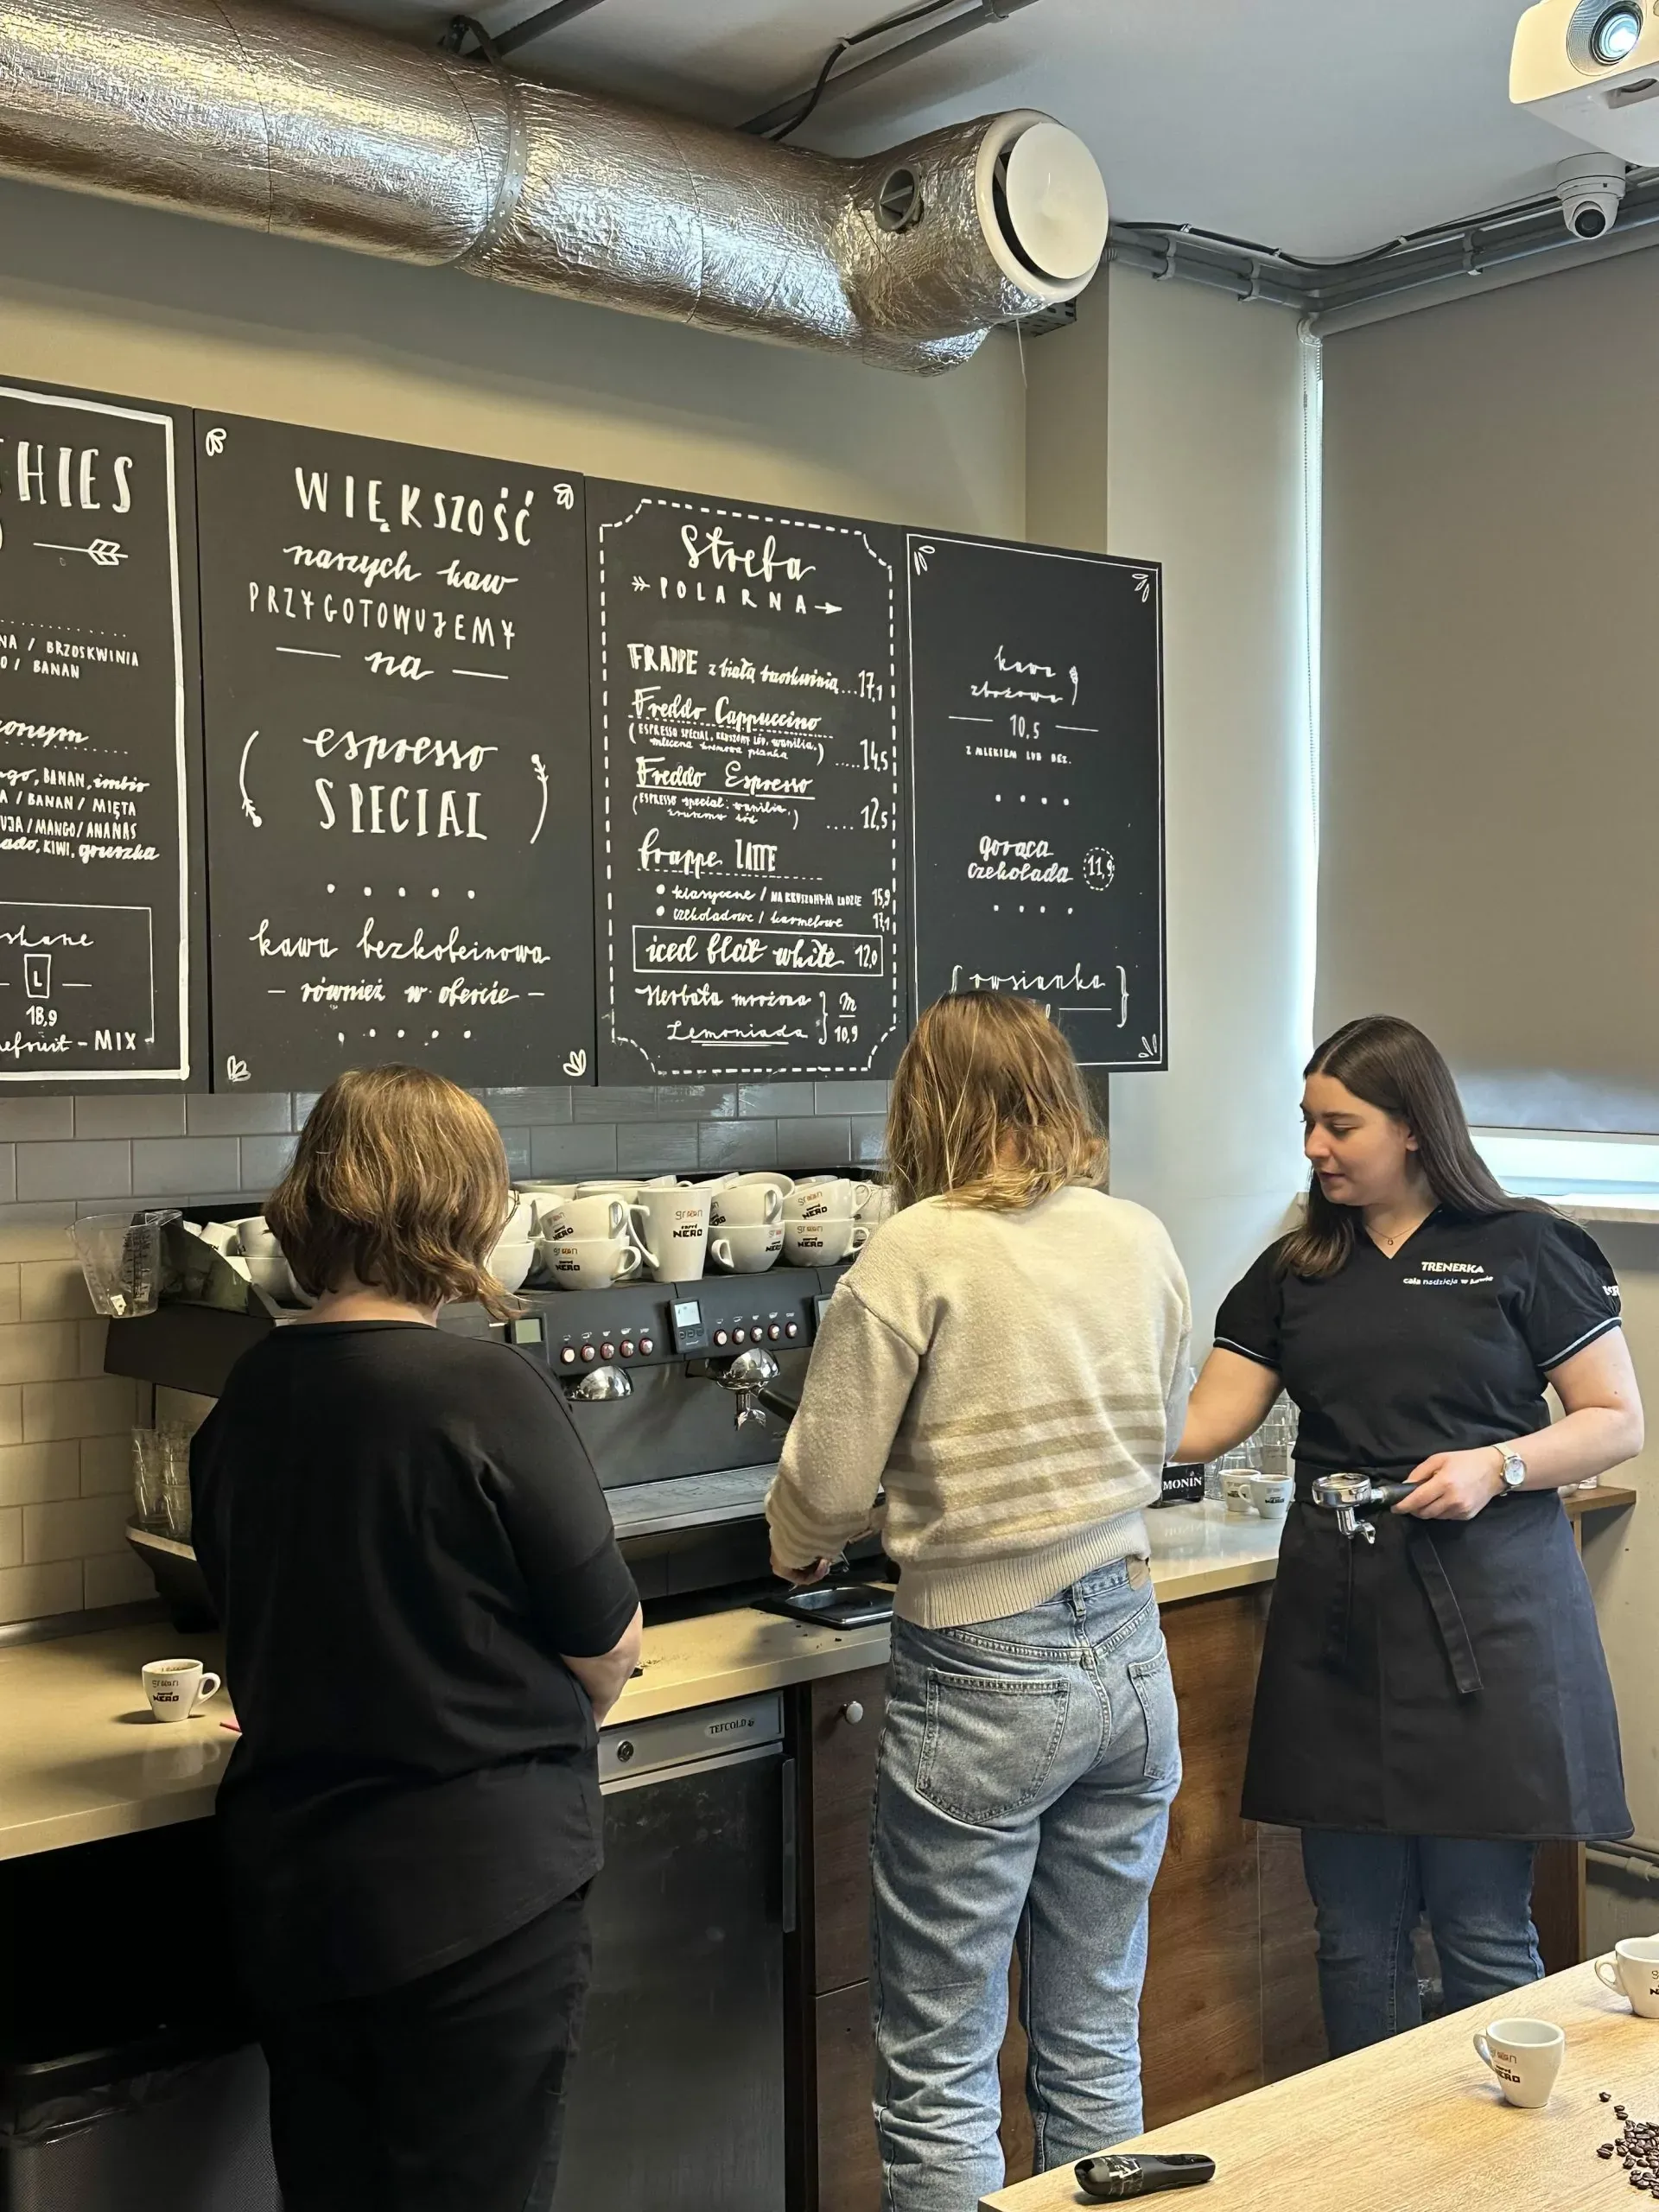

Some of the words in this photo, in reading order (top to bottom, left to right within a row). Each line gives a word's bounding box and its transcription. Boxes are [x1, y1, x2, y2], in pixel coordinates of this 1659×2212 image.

[0, 438, 132, 513] HIES
[295, 467, 535, 546] WIĘKSZOŚĆ
[681, 524, 816, 582] Strefa
[283, 544, 423, 588] naszych
[435, 559, 519, 595] kaw
[660, 576, 806, 614] POLARNA
[249, 582, 516, 650] PRZYGOTOWUJEMY
[47, 640, 138, 667] BRZOSKWINIA
[365, 651, 435, 681] na
[627, 643, 698, 675] FRAPPE
[708, 663, 716, 677] z
[33, 659, 79, 679] BANAN
[632, 685, 707, 719] Freddo
[715, 695, 822, 733] Cappuccino
[0, 720, 89, 745] onym
[302, 728, 499, 772] espresso
[975, 747, 1017, 760] MLEKIEM
[636, 756, 707, 787] Freddo
[724, 760, 814, 795] Espresso
[28, 792, 73, 810] BANAN
[92, 798, 136, 820] MIĘTA
[315, 778, 488, 841] SPECIAL
[86, 822, 137, 840] ANANAS
[79, 843, 160, 864] gruszka
[735, 838, 778, 872] LATTE
[979, 835, 1054, 861] gorąca
[771, 891, 783, 904] NA
[673, 907, 754, 923] czekoladowe
[770, 911, 843, 929] karmelowe
[249, 918, 338, 958] kawa
[645, 934, 698, 963] iced
[772, 938, 845, 969] white
[33, 970, 43, 987] L
[300, 976, 386, 1003] również
[404, 985, 429, 1003] w
[969, 962, 1106, 990] owsianka
[26, 1005, 58, 1027] 18,9
[94, 1029, 137, 1052] MIX
[666, 1020, 809, 1041] Lemoniada
[673, 1229, 703, 1238] NERO
[1421, 1261, 1484, 1274] TRENERKA
[1162, 1476, 1203, 1491] MONIN
[709, 1719, 747, 1734] TEFCOLD
